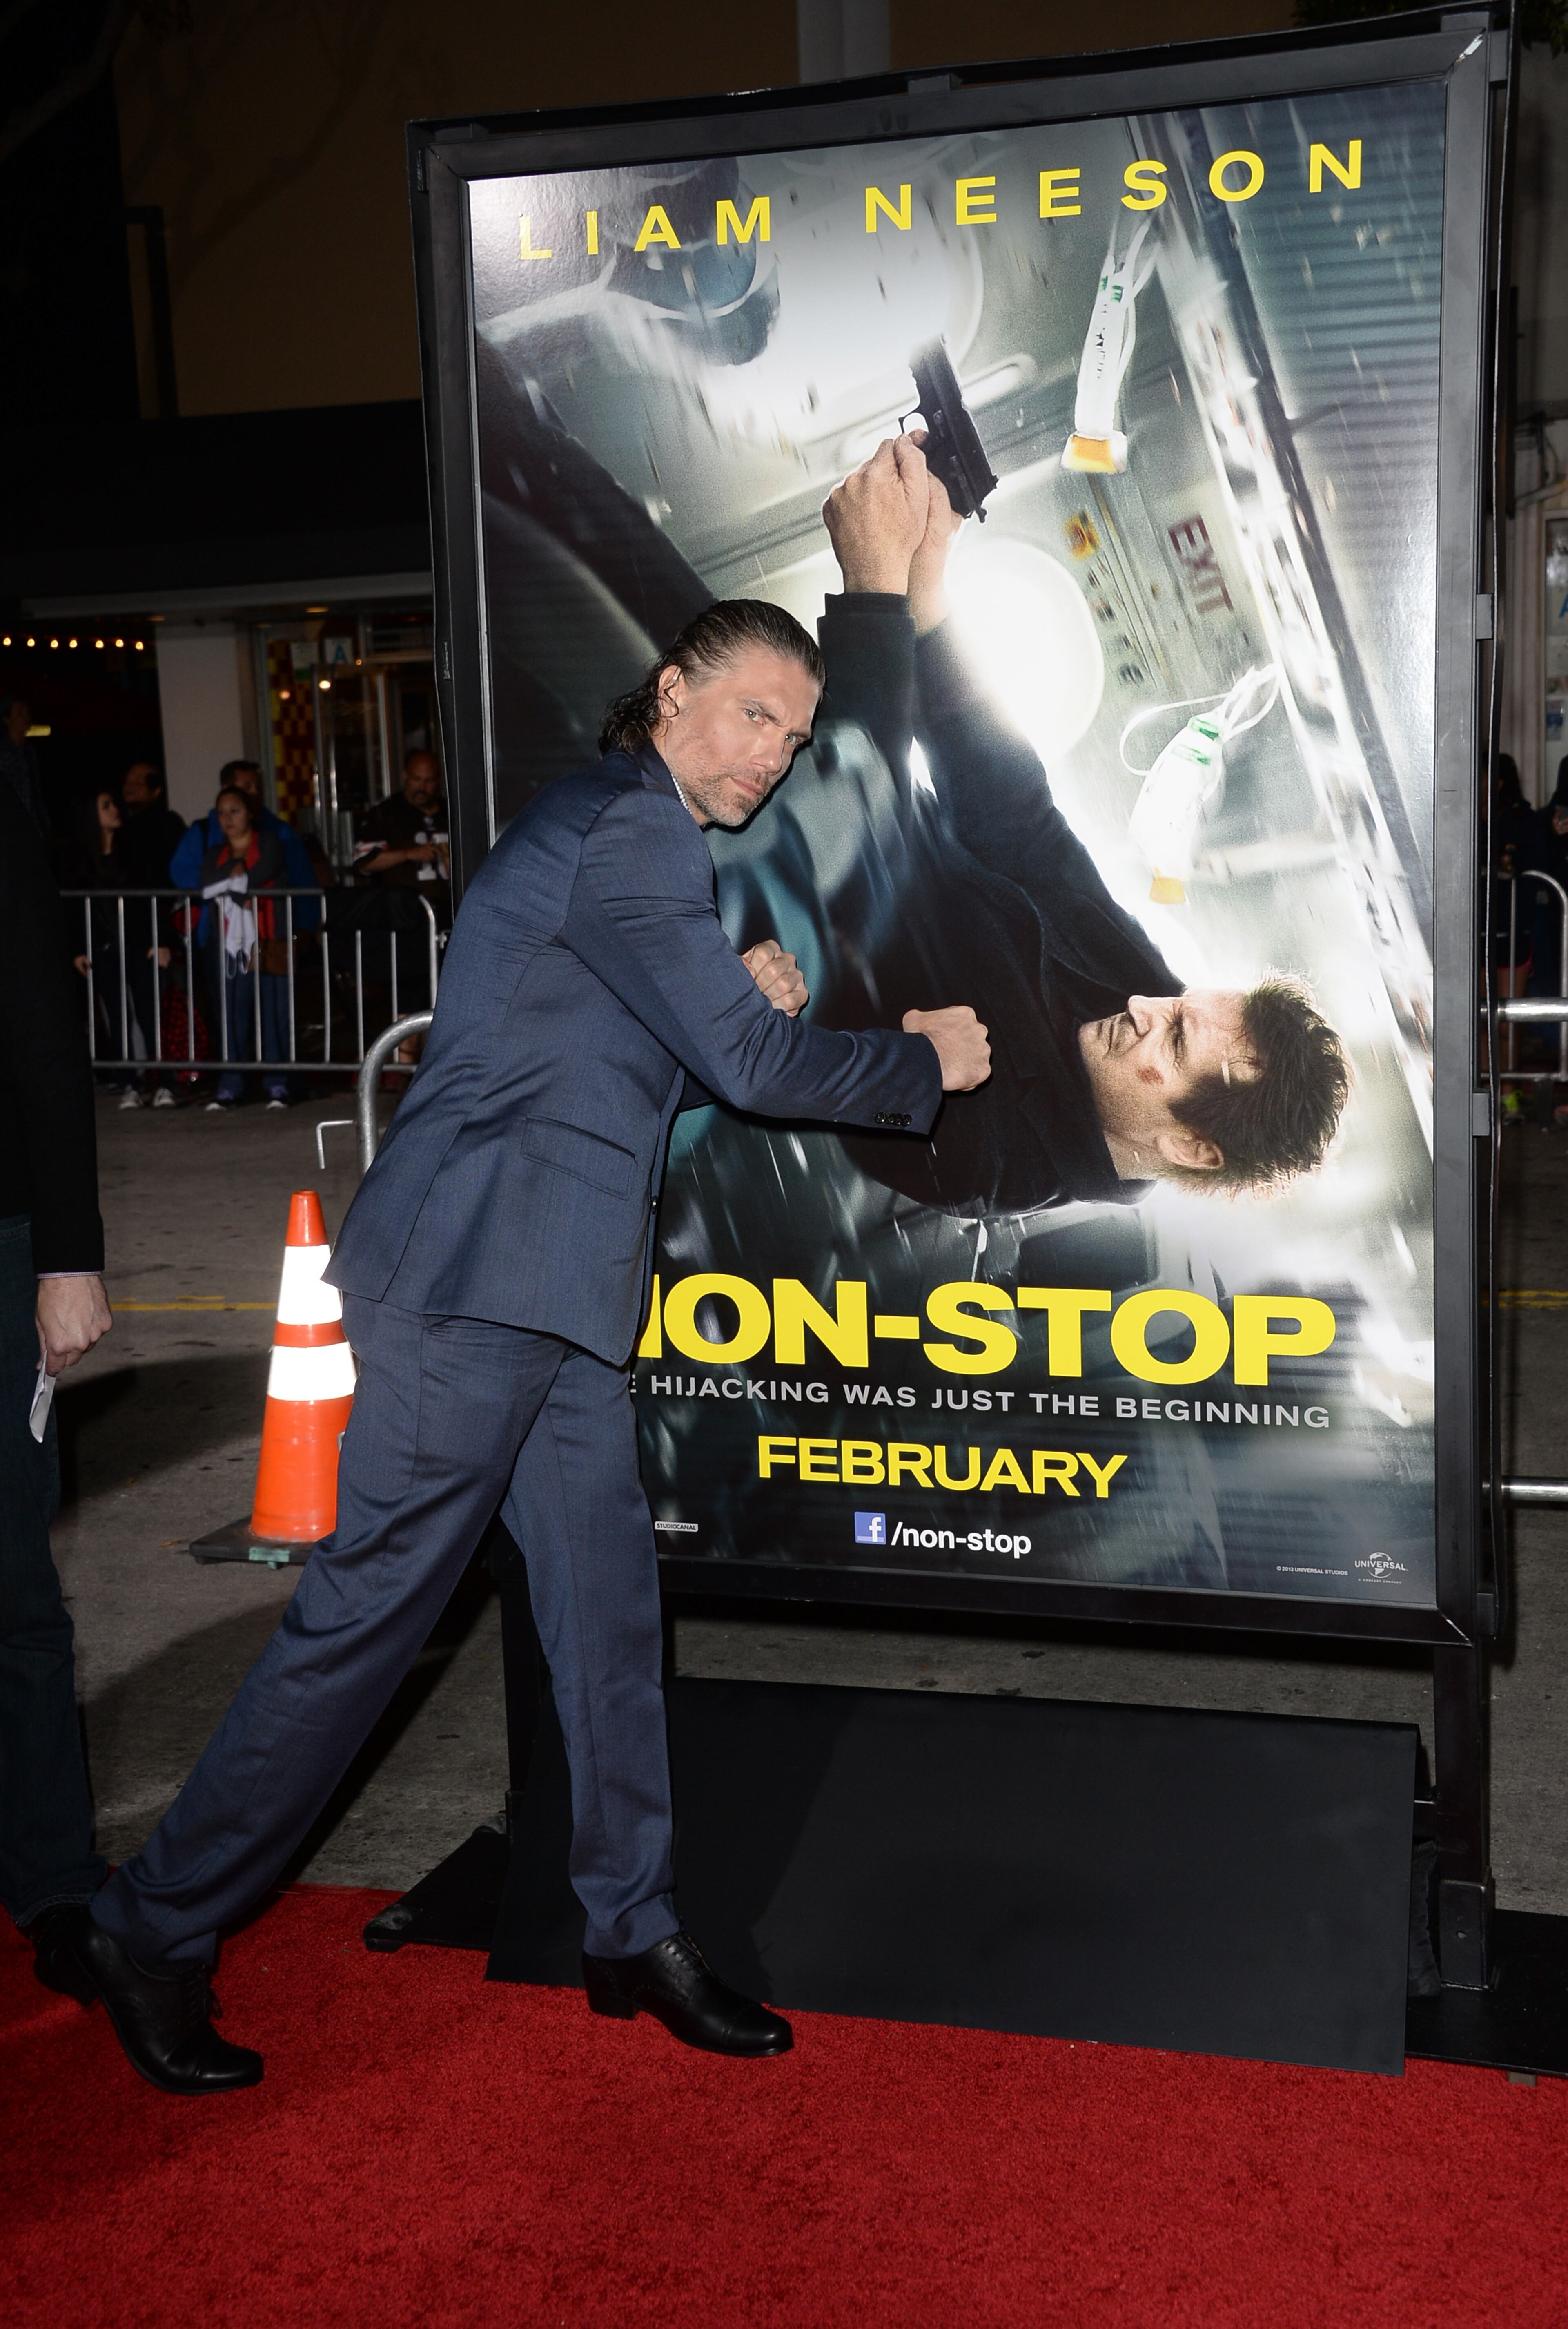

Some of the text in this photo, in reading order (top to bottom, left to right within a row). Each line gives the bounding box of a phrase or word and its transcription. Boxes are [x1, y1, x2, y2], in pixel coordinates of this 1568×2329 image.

[520, 140, 1362, 260] LIAM NEESON
[1168, 513, 1234, 616] EXIT
[638, 1273, 1336, 1386] ON-STOP
[651, 1375, 829, 1403] HIJACKING
[843, 1384, 916, 1407] WAS
[932, 1389, 1015, 1412] JUST
[1029, 1393, 1099, 1416] THE
[1116, 1397, 1330, 1428] BEGINNING
[758, 1435, 1128, 1498] FEBRUARY
[891, 1521, 1031, 1559] /non-stop
[1354, 1560, 1406, 1571] UNIVERSAL
